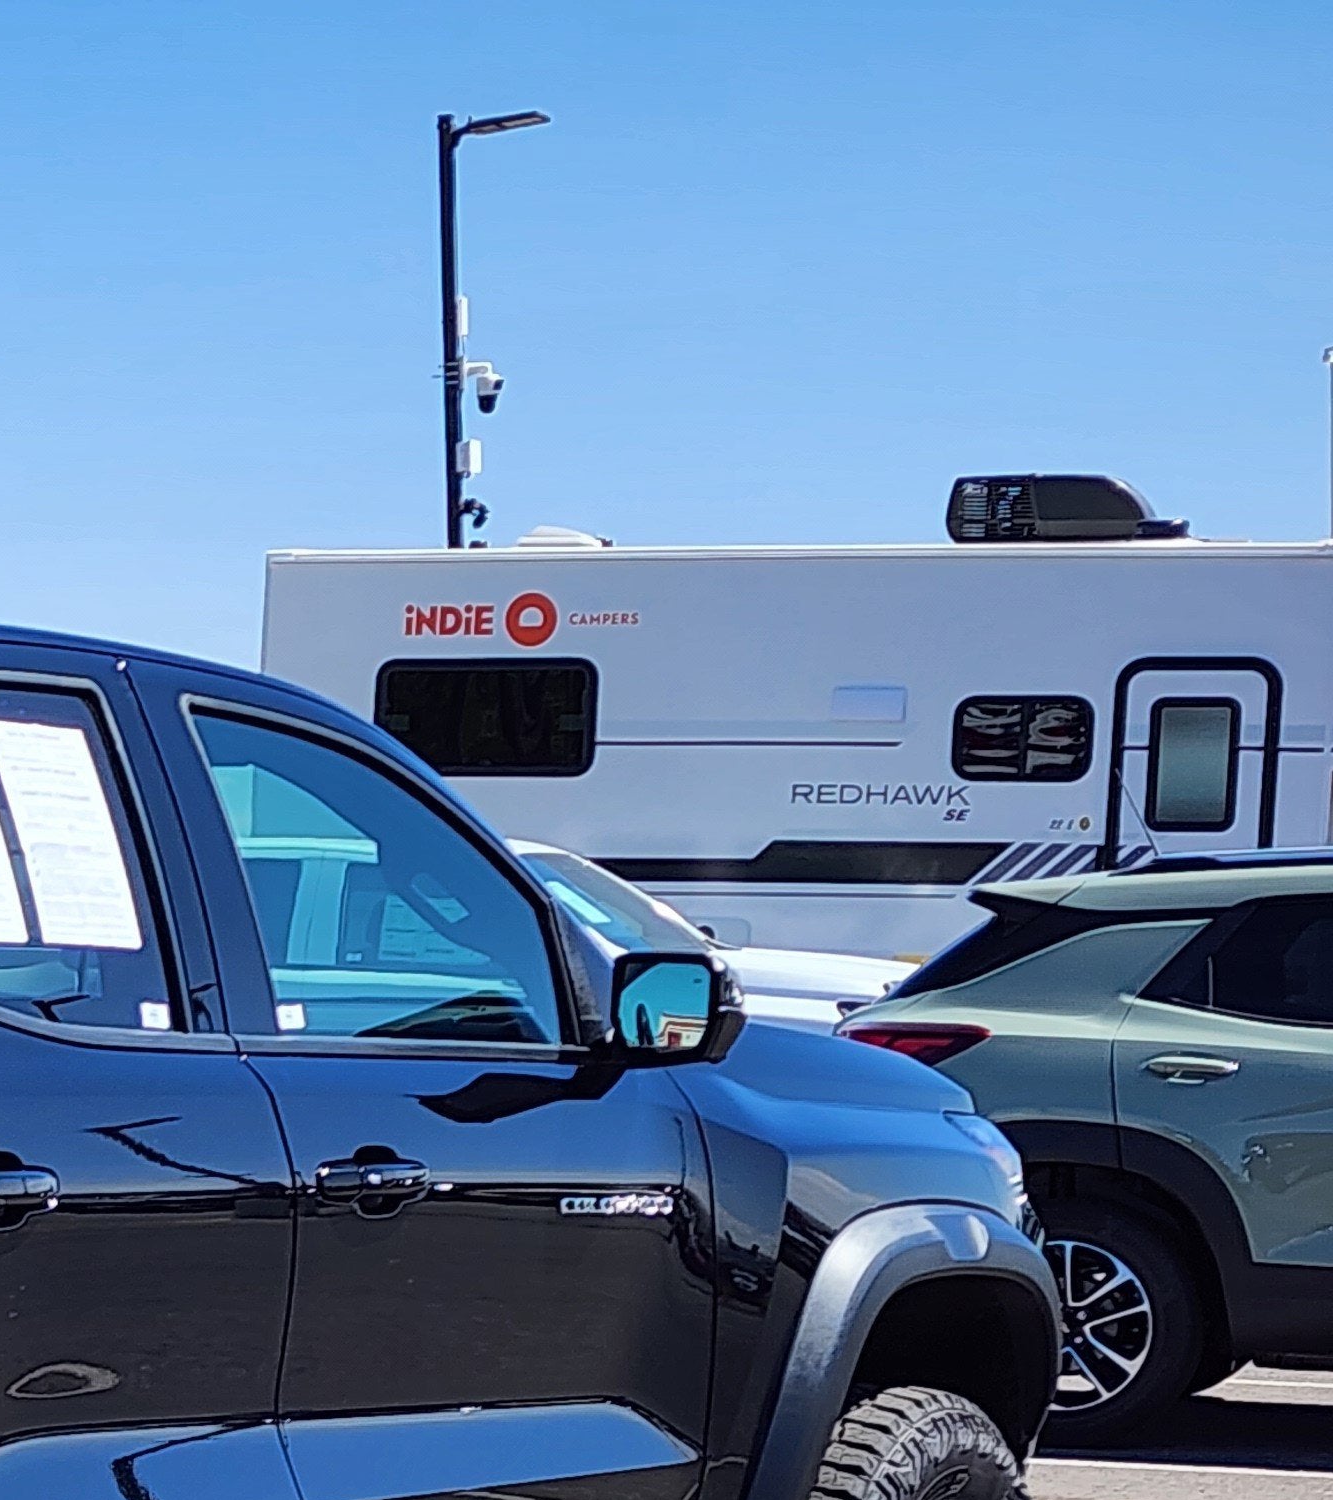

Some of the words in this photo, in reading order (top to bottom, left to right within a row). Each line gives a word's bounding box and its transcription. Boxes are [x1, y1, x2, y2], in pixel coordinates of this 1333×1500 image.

[568, 612, 640, 626] CAMPERS
[790, 783, 971, 806] REDHAWK
[943, 808, 971, 822] SE
